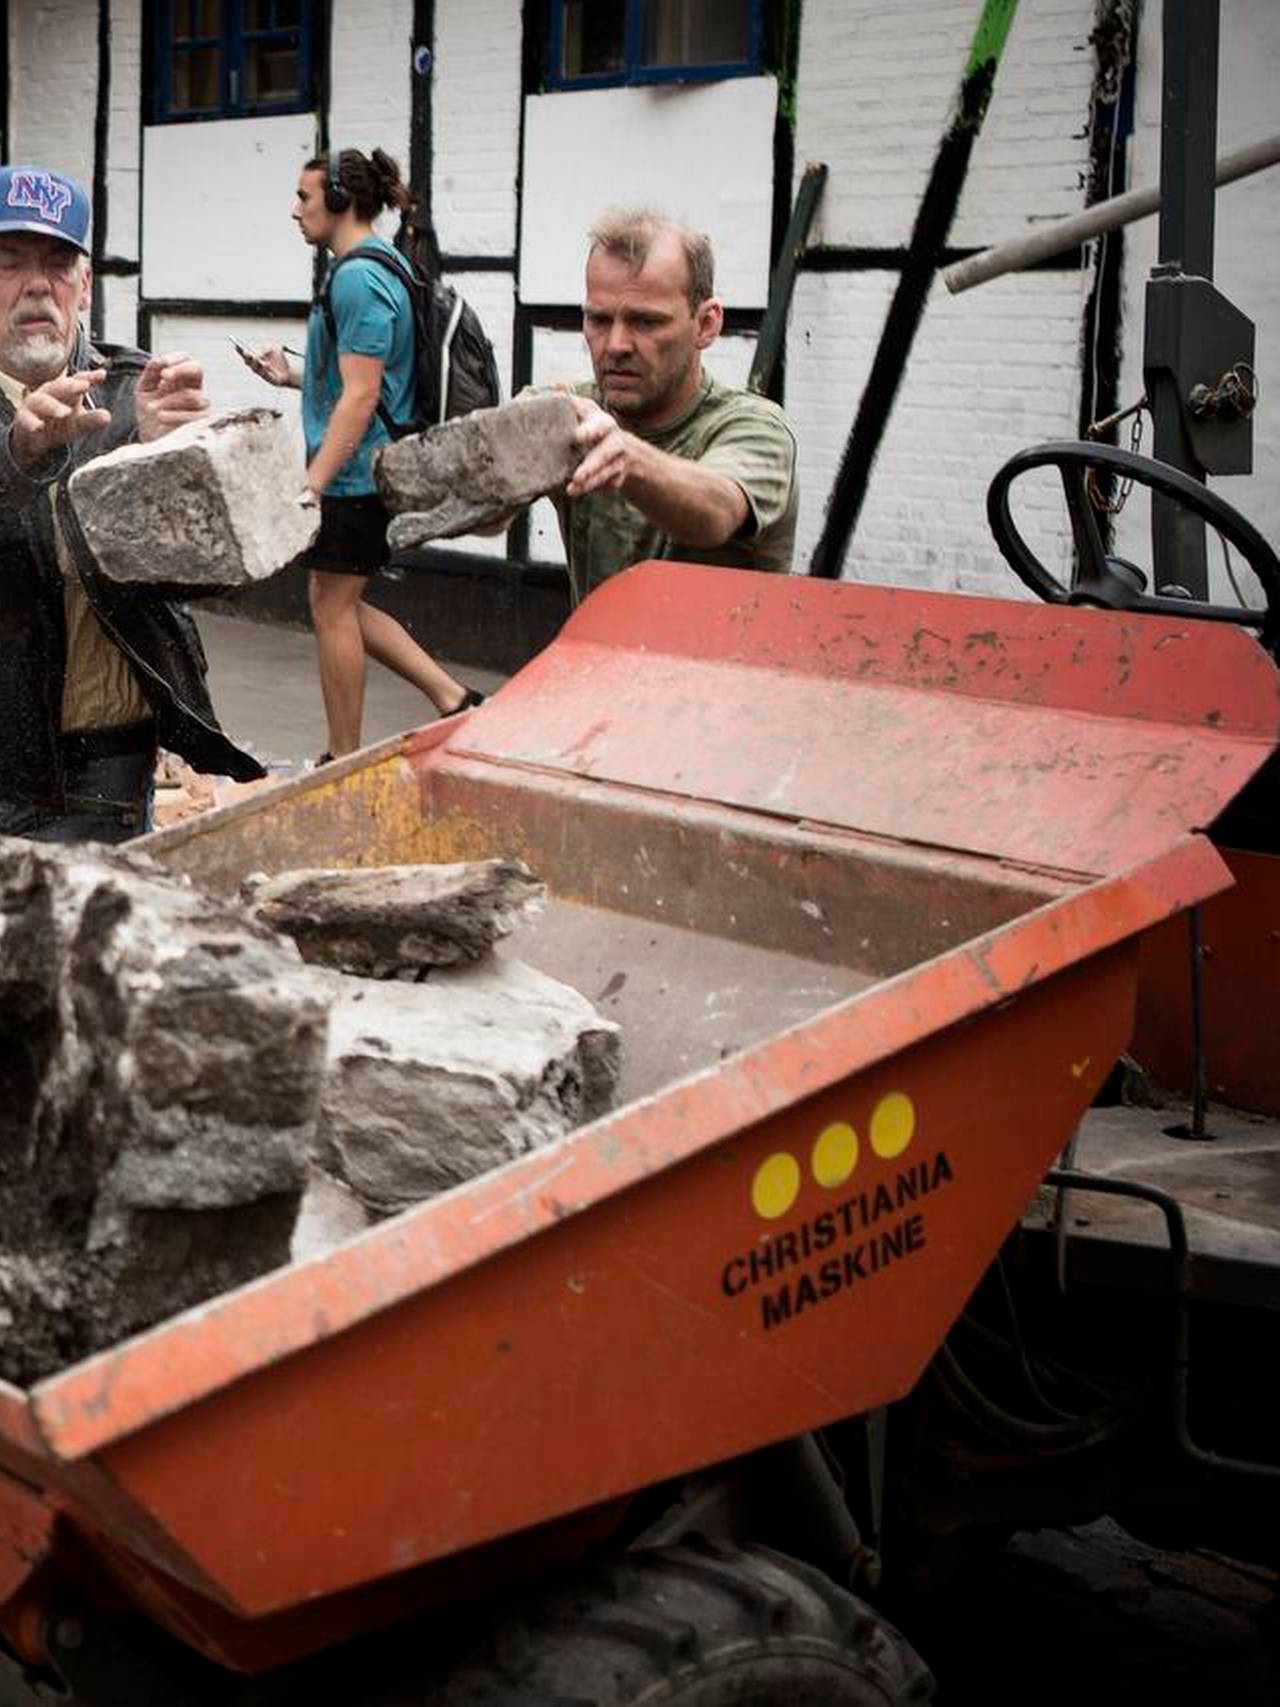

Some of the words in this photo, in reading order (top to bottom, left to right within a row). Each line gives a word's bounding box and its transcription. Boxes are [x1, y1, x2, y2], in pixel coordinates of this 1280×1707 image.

[8, 170, 71, 224] NY
[721, 1151, 953, 1297] CHRISTIANIA
[761, 1215, 926, 1330] MASKINE
